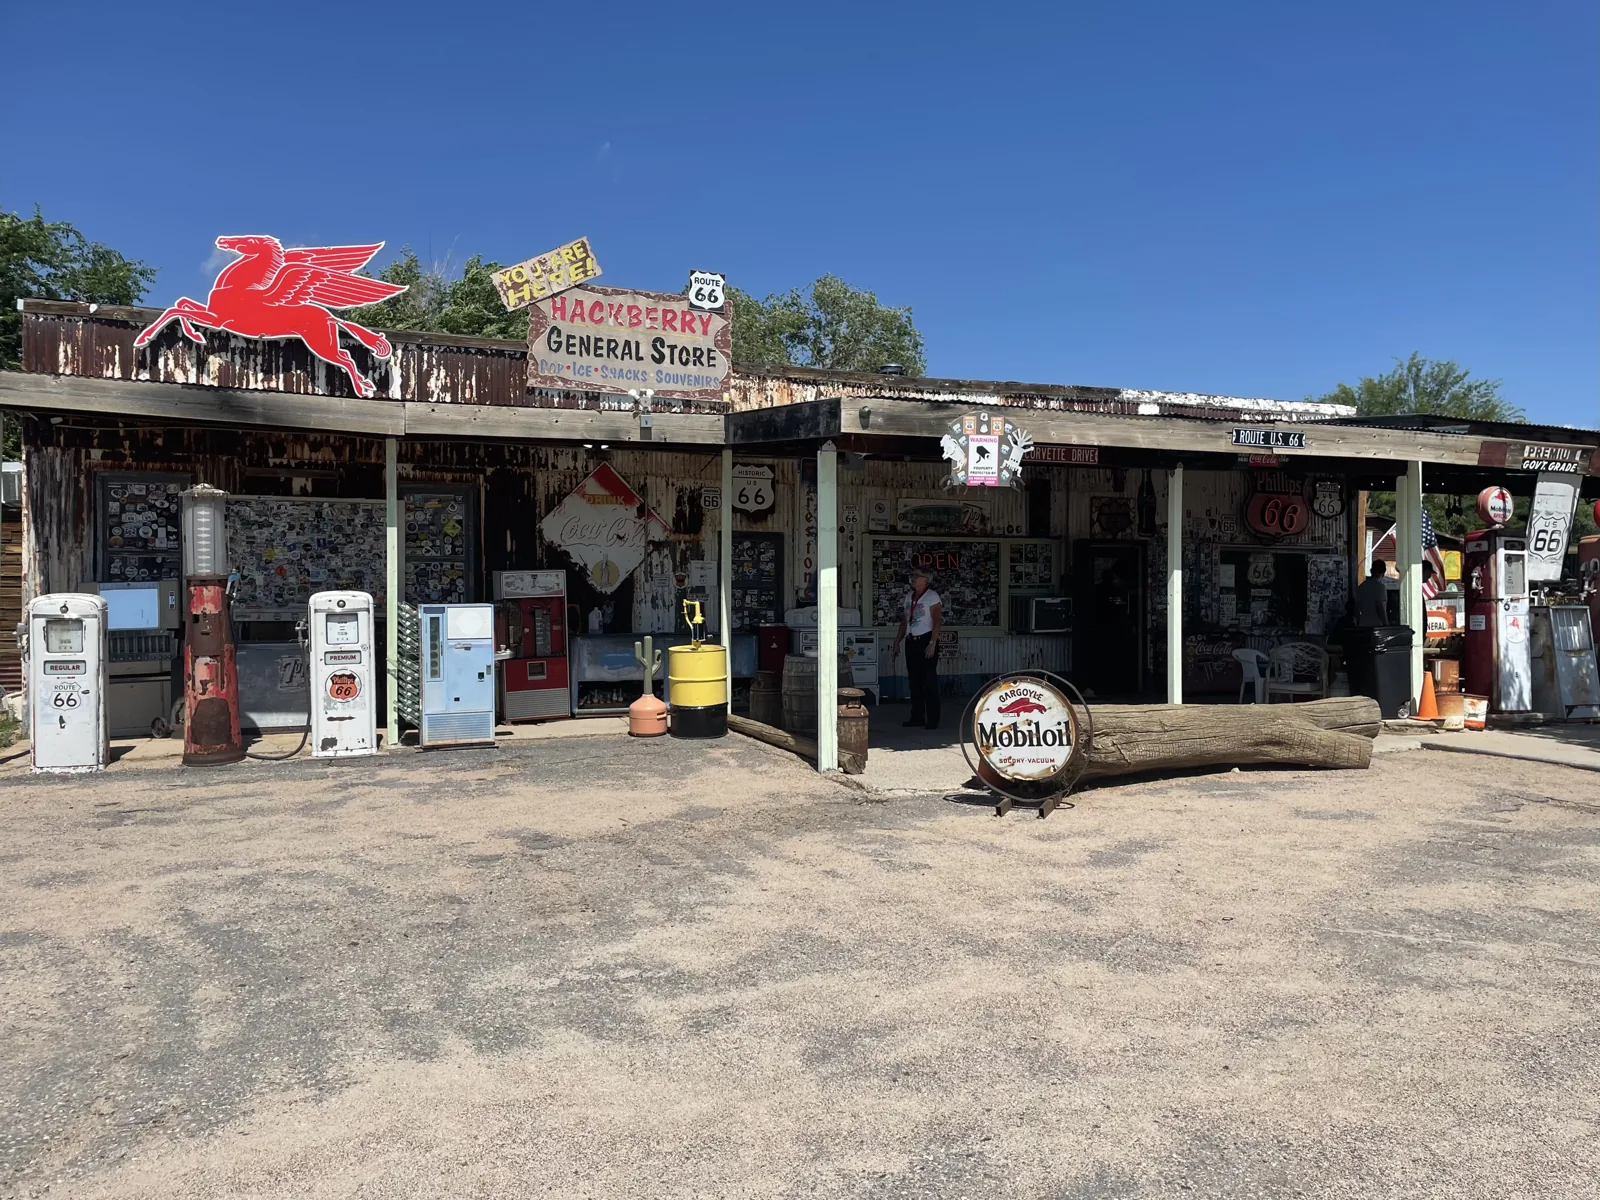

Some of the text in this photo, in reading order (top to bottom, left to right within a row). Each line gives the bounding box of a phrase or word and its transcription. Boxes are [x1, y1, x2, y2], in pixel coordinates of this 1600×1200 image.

[500, 243, 587, 287] YOU ARE
[695, 277, 721, 286] ROUTE
[694, 287, 719, 303] 66
[551, 296, 713, 337] HACKBERRY
[547, 325, 717, 368] GENERAL STORE
[572, 361, 592, 377] ICE
[600, 364, 648, 382] SNACKS
[655, 369, 721, 389] SOUVENIRS
[1240, 430, 1299, 446] ROUTE U.S. 66
[1024, 447, 1095, 462] CORVETTE DRIVE
[1522, 460, 1578, 472] GOVT. GRADE
[1256, 471, 1302, 498] Phillips
[1318, 483, 1338, 491] ROUTE
[586, 496, 625, 505] DRINK
[703, 495, 719, 507] 66
[738, 487, 766, 505] 66
[1319, 500, 1335, 514] 66
[845, 515, 858, 523] 66
[1261, 499, 1300, 532] 66
[1223, 521, 1235, 531] 66
[1533, 529, 1562, 552] 66
[910, 551, 961, 571] OPEN
[1253, 564, 1272, 579] 66
[938, 633, 953, 642] NGER
[336, 685, 353, 696] 66
[998, 688, 1044, 703] GARGOYLE
[53, 692, 78, 708] 66
[977, 719, 1073, 748] Mobiloil
